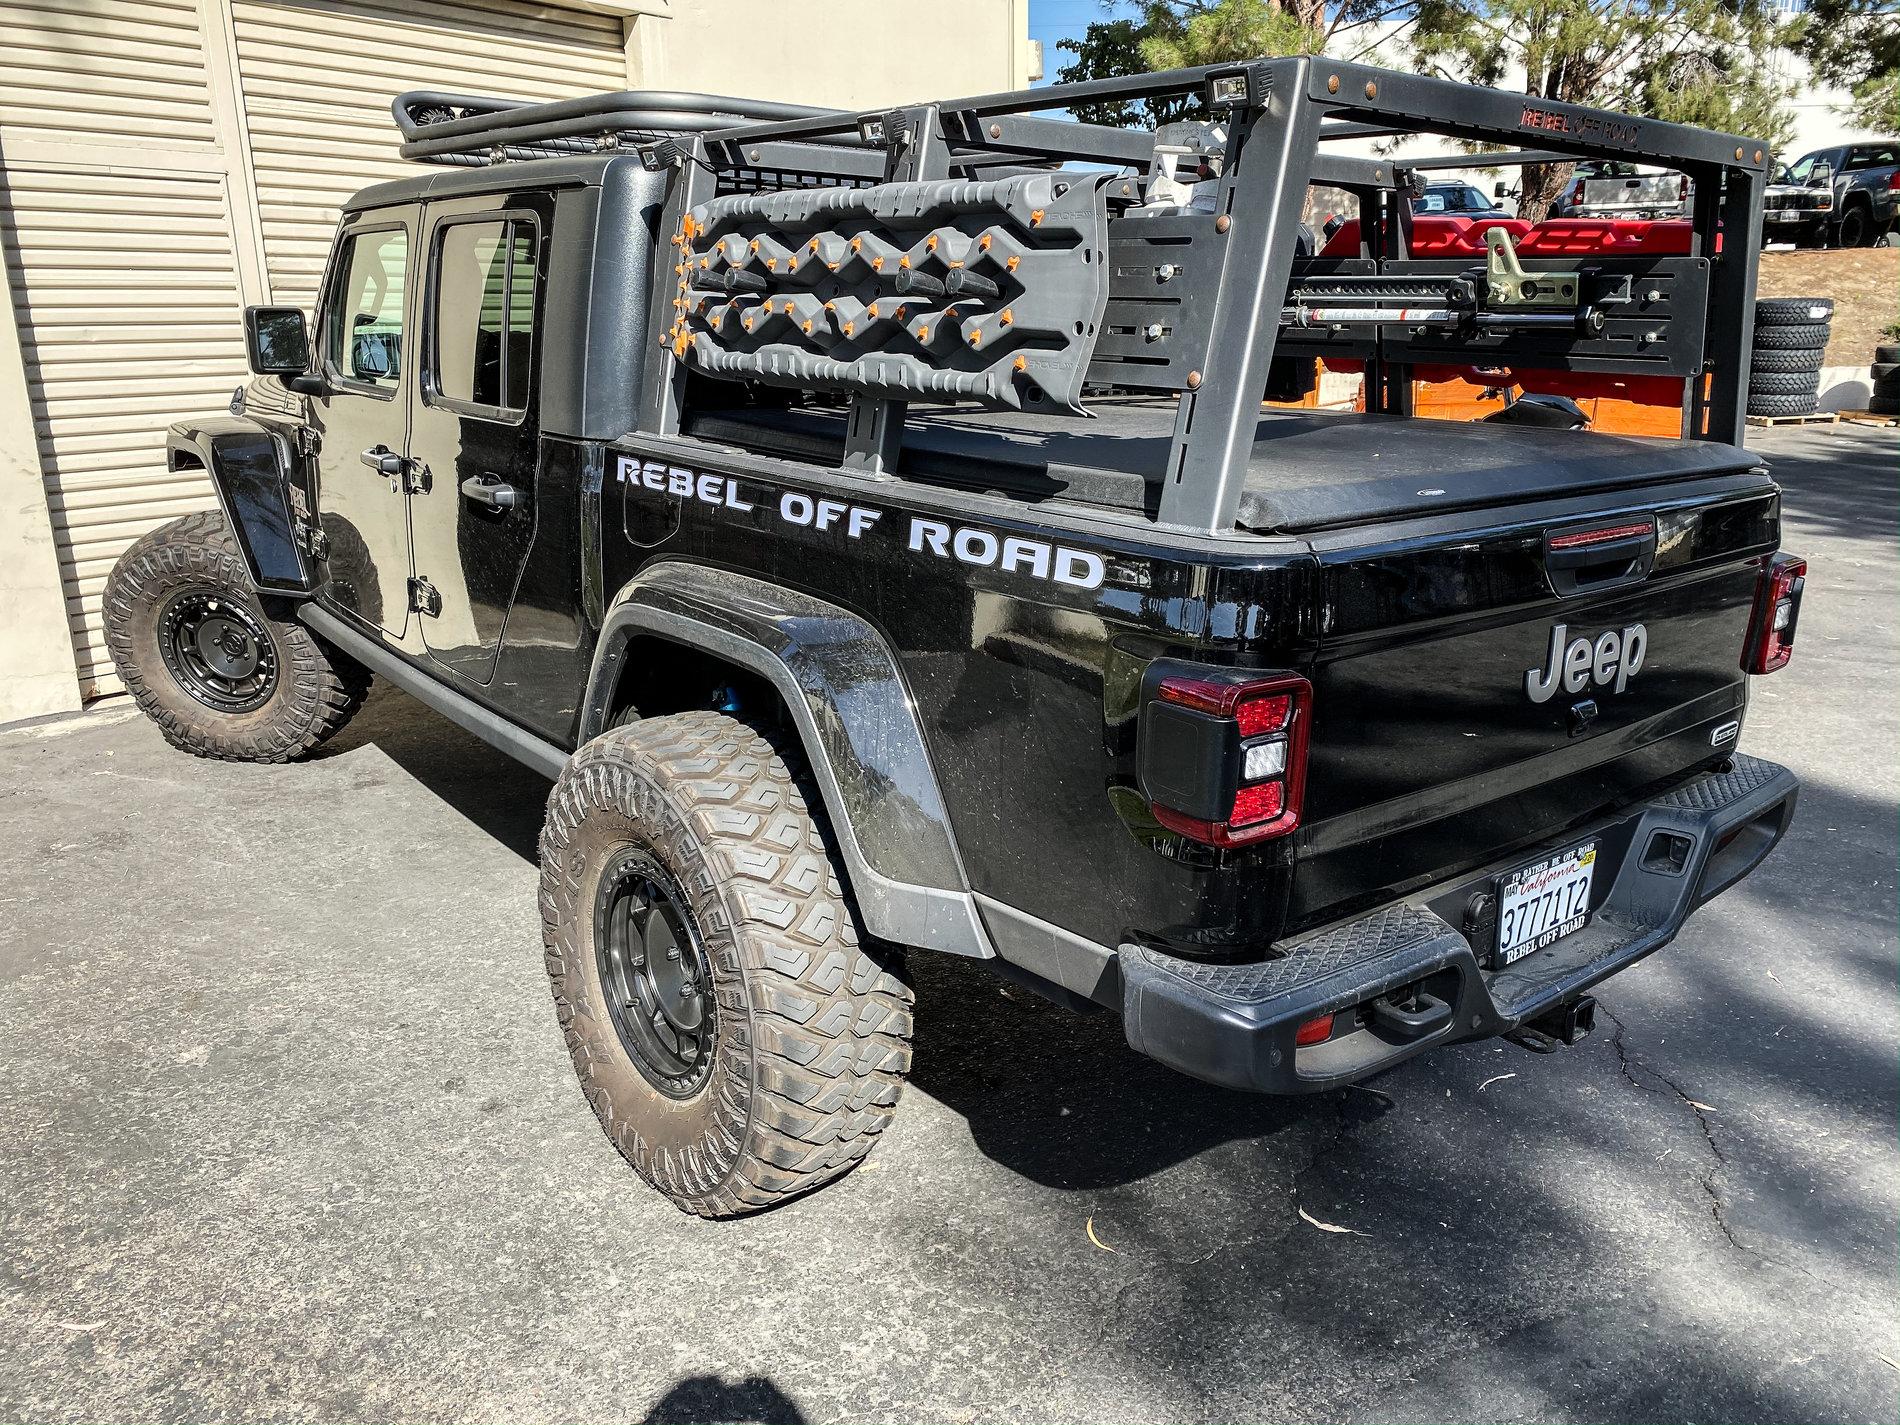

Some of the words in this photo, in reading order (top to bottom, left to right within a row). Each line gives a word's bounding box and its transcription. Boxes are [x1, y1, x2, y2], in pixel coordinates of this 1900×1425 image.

[1520, 107, 1570, 133] REBEL
[1573, 113, 1601, 136] OFF
[1601, 120, 1640, 145] ROAD
[616, 455, 754, 513] REBEL
[780, 490, 882, 540] OFF
[908, 515, 1107, 591] ROAD
[1526, 623, 1648, 703] Jeep
[1520, 862, 1580, 896] California
[1523, 860, 1549, 877] RATHER
[1552, 855, 1561, 867] BE
[1563, 850, 1576, 862] OFF
[1506, 938, 1538, 965] REBEL
[1539, 927, 1559, 948] OFF
[1559, 915, 1586, 938] ROAD
